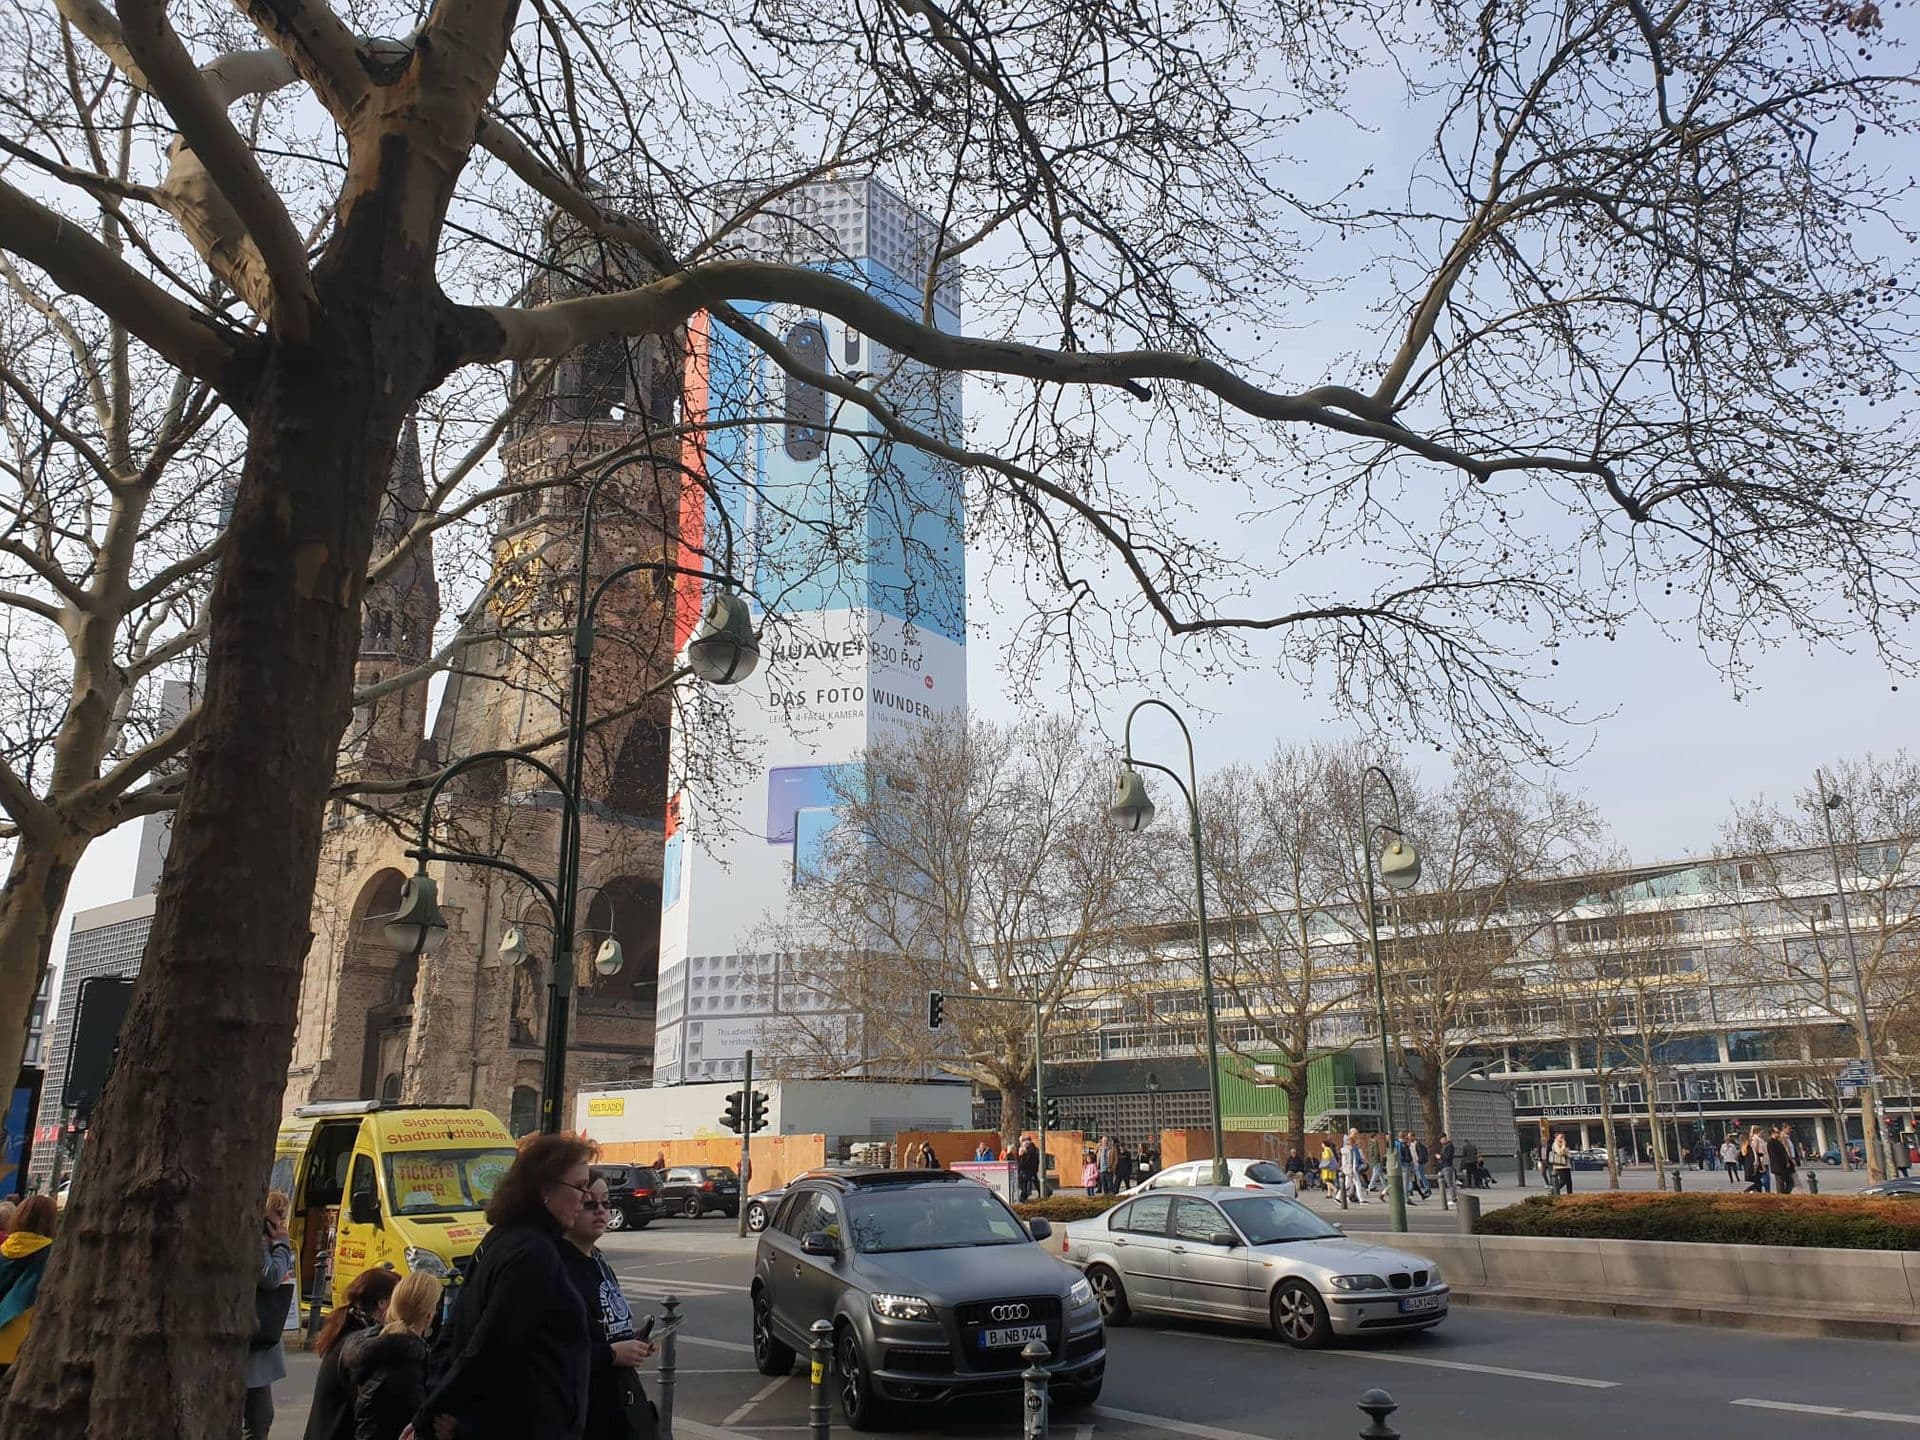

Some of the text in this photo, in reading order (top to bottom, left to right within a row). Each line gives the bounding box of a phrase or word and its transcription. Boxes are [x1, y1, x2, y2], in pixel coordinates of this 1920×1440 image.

[771, 639, 865, 660] HUAWEI
[901, 651, 921, 671] Pro
[770, 690, 806, 707] DAS
[816, 686, 864, 704] FOTO
[828, 709, 864, 720] KAMERA
[1543, 1107, 1572, 1117] BIKINI
[402, 1118, 484, 1127] Sightseeing
[387, 1129, 507, 1145] Stadtrundfahrten
[990, 1326, 1042, 1344] B NB 944
